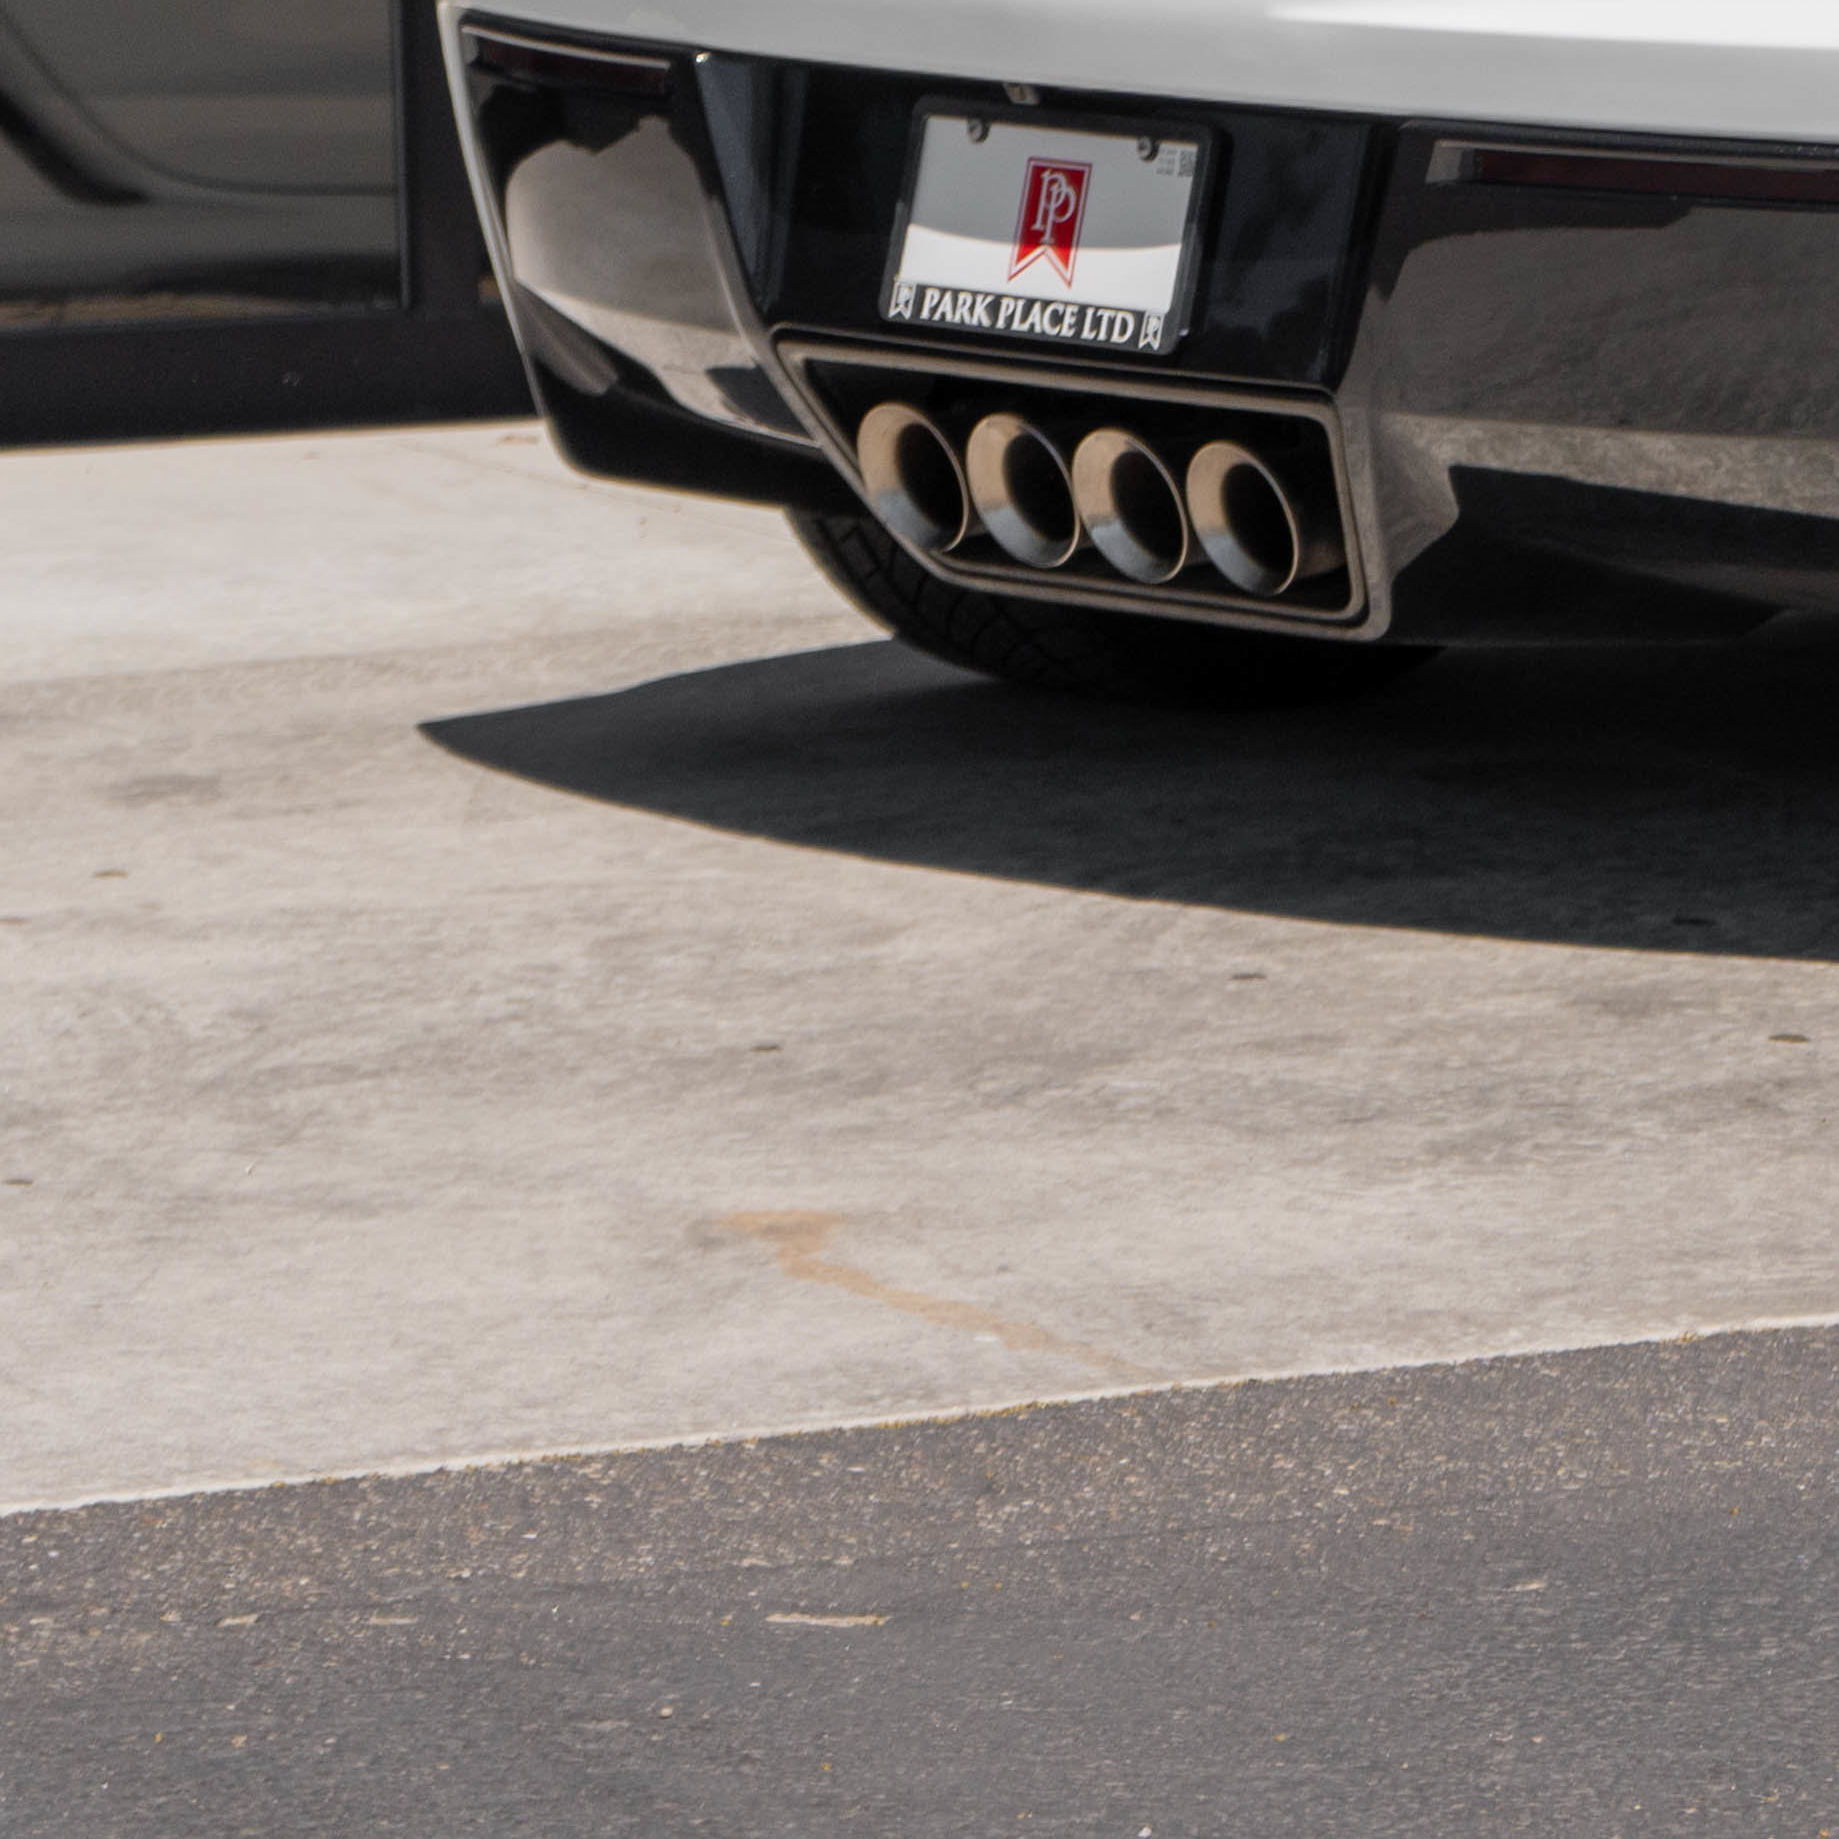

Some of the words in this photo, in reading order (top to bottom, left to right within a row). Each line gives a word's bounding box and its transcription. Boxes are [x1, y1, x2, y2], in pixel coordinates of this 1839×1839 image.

[919, 287, 996, 328] PARK
[995, 295, 1081, 339] PLACE
[1080, 305, 1136, 345] LTD
